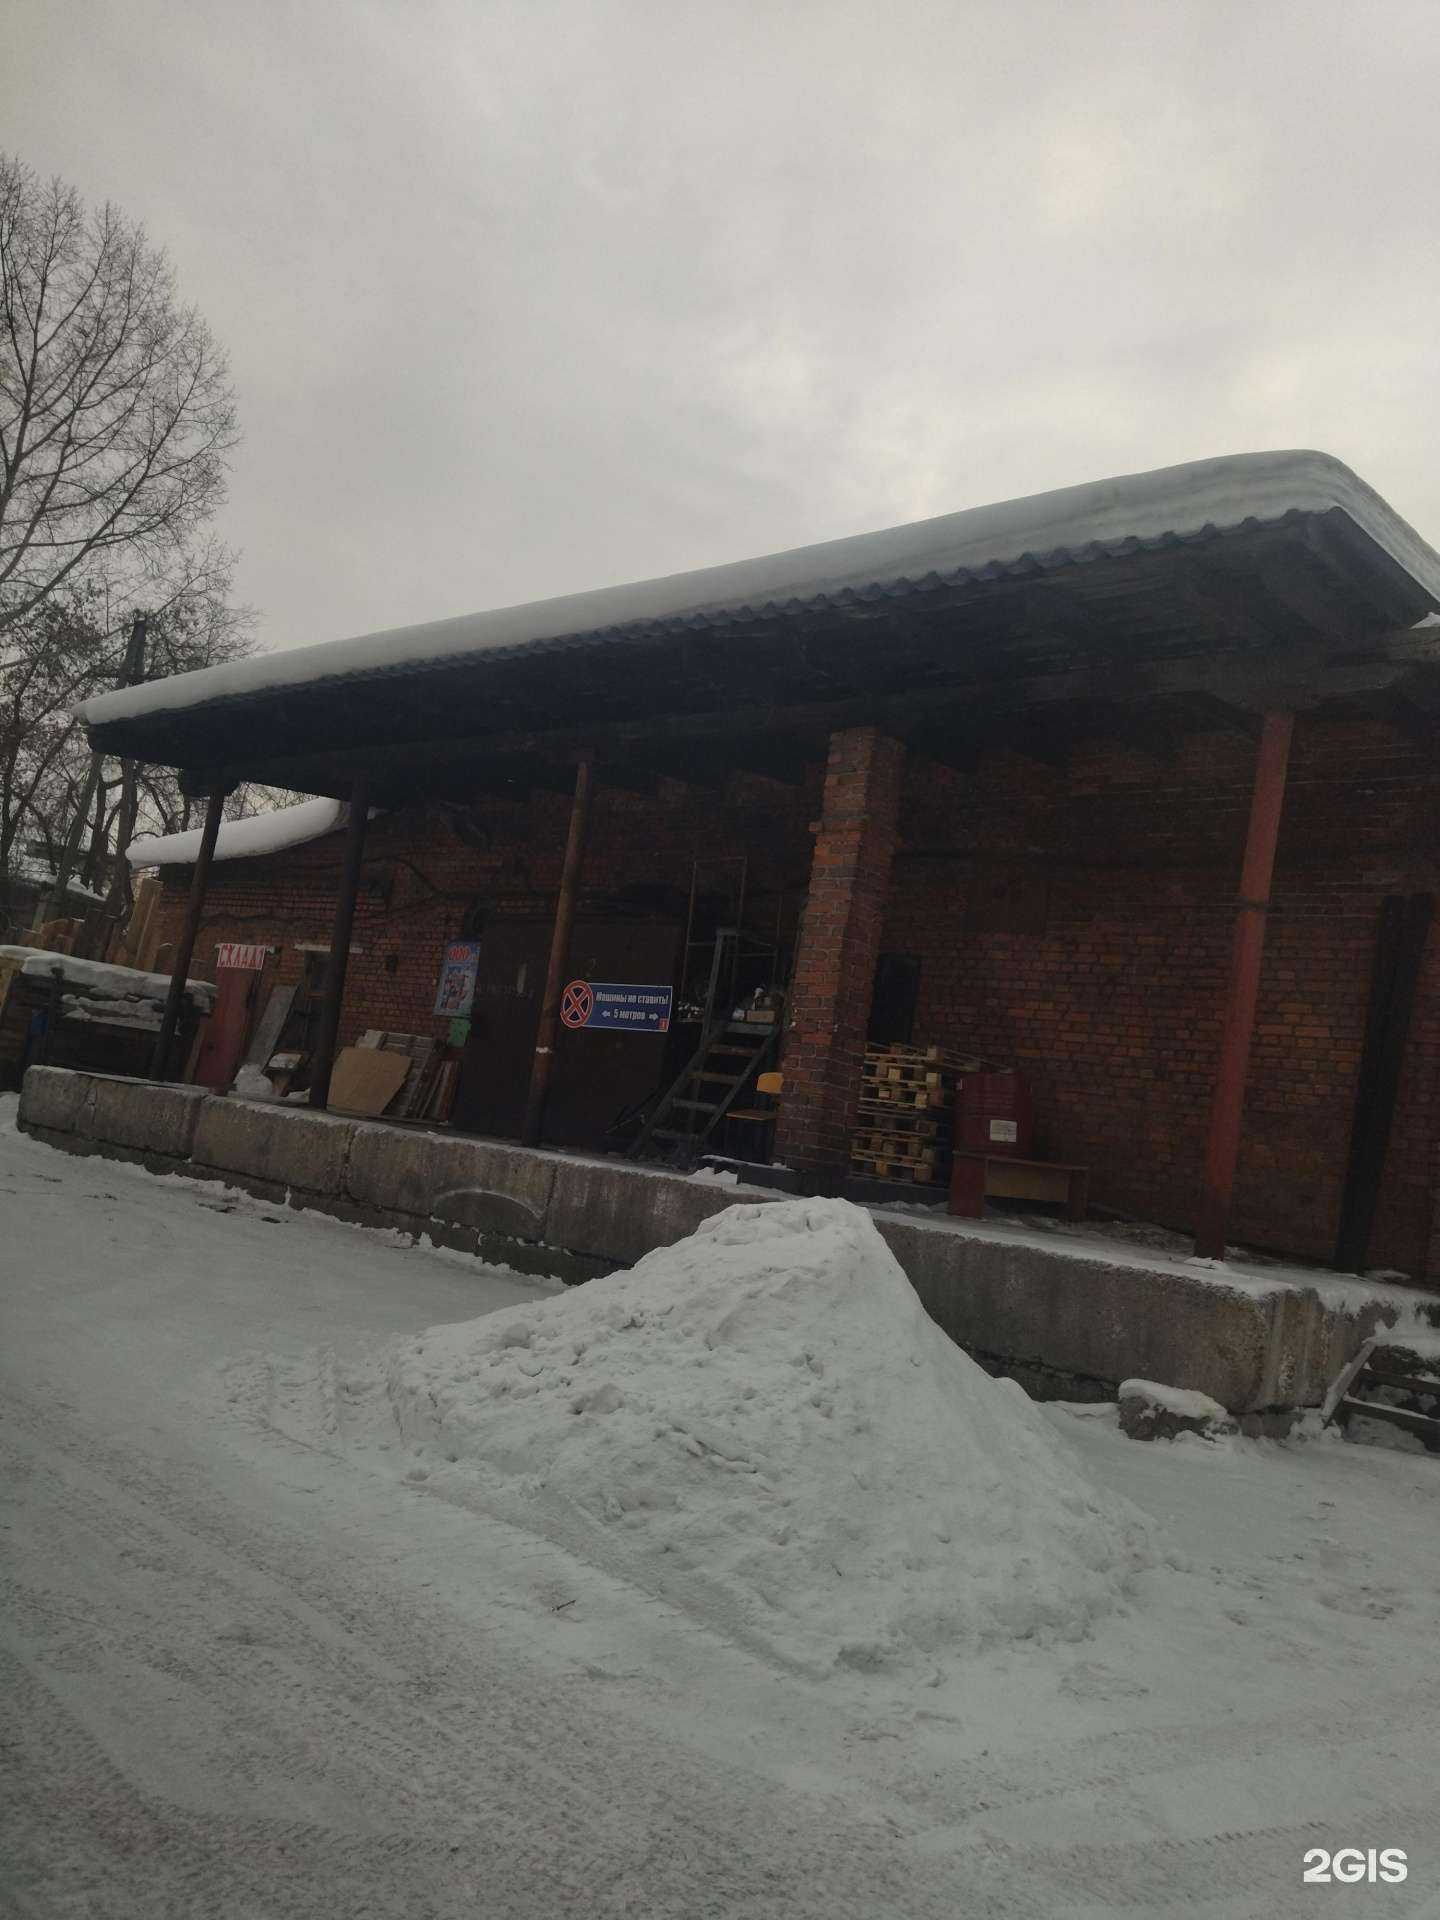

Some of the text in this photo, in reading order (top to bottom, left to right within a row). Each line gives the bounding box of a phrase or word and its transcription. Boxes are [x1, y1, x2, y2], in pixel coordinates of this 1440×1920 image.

[596, 992, 669, 1004] Машины не ставить!
[613, 1009, 646, 1020] 5 метров
